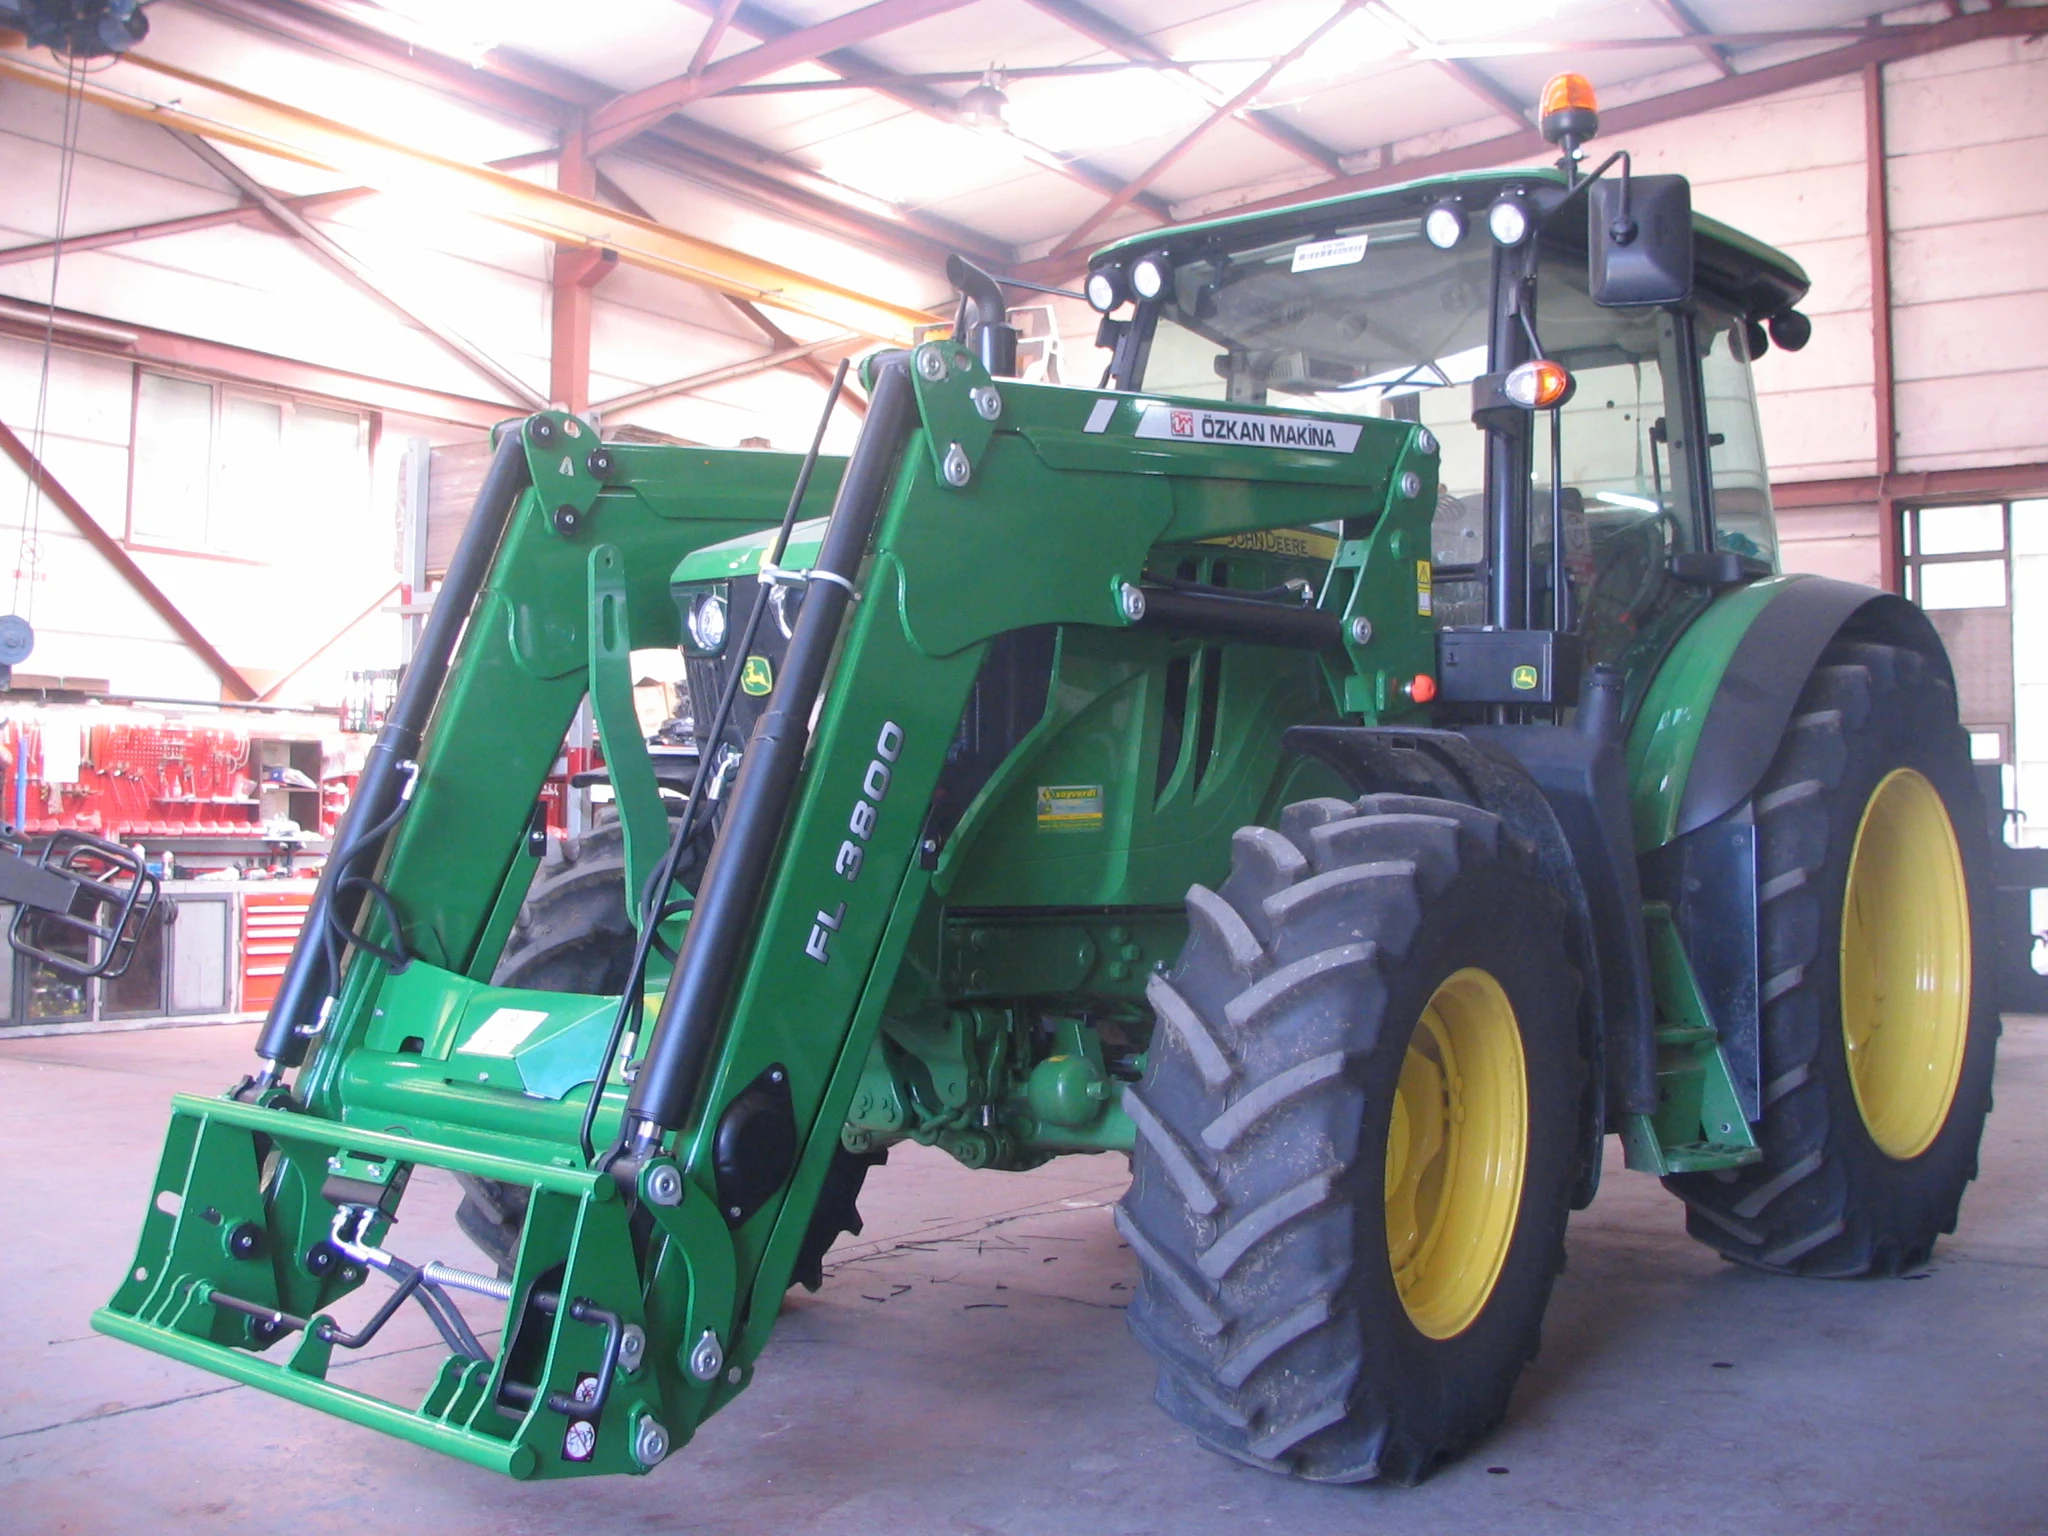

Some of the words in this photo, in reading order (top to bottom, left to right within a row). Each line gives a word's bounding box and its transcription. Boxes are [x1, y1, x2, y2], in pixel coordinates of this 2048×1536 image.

[1202, 414, 1264, 442] ÖZKAN
[1270, 423, 1336, 448] MAKİNA
[1265, 531, 1308, 554] DEERE
[804, 900, 848, 965] FL
[835, 720, 904, 881] 3800
